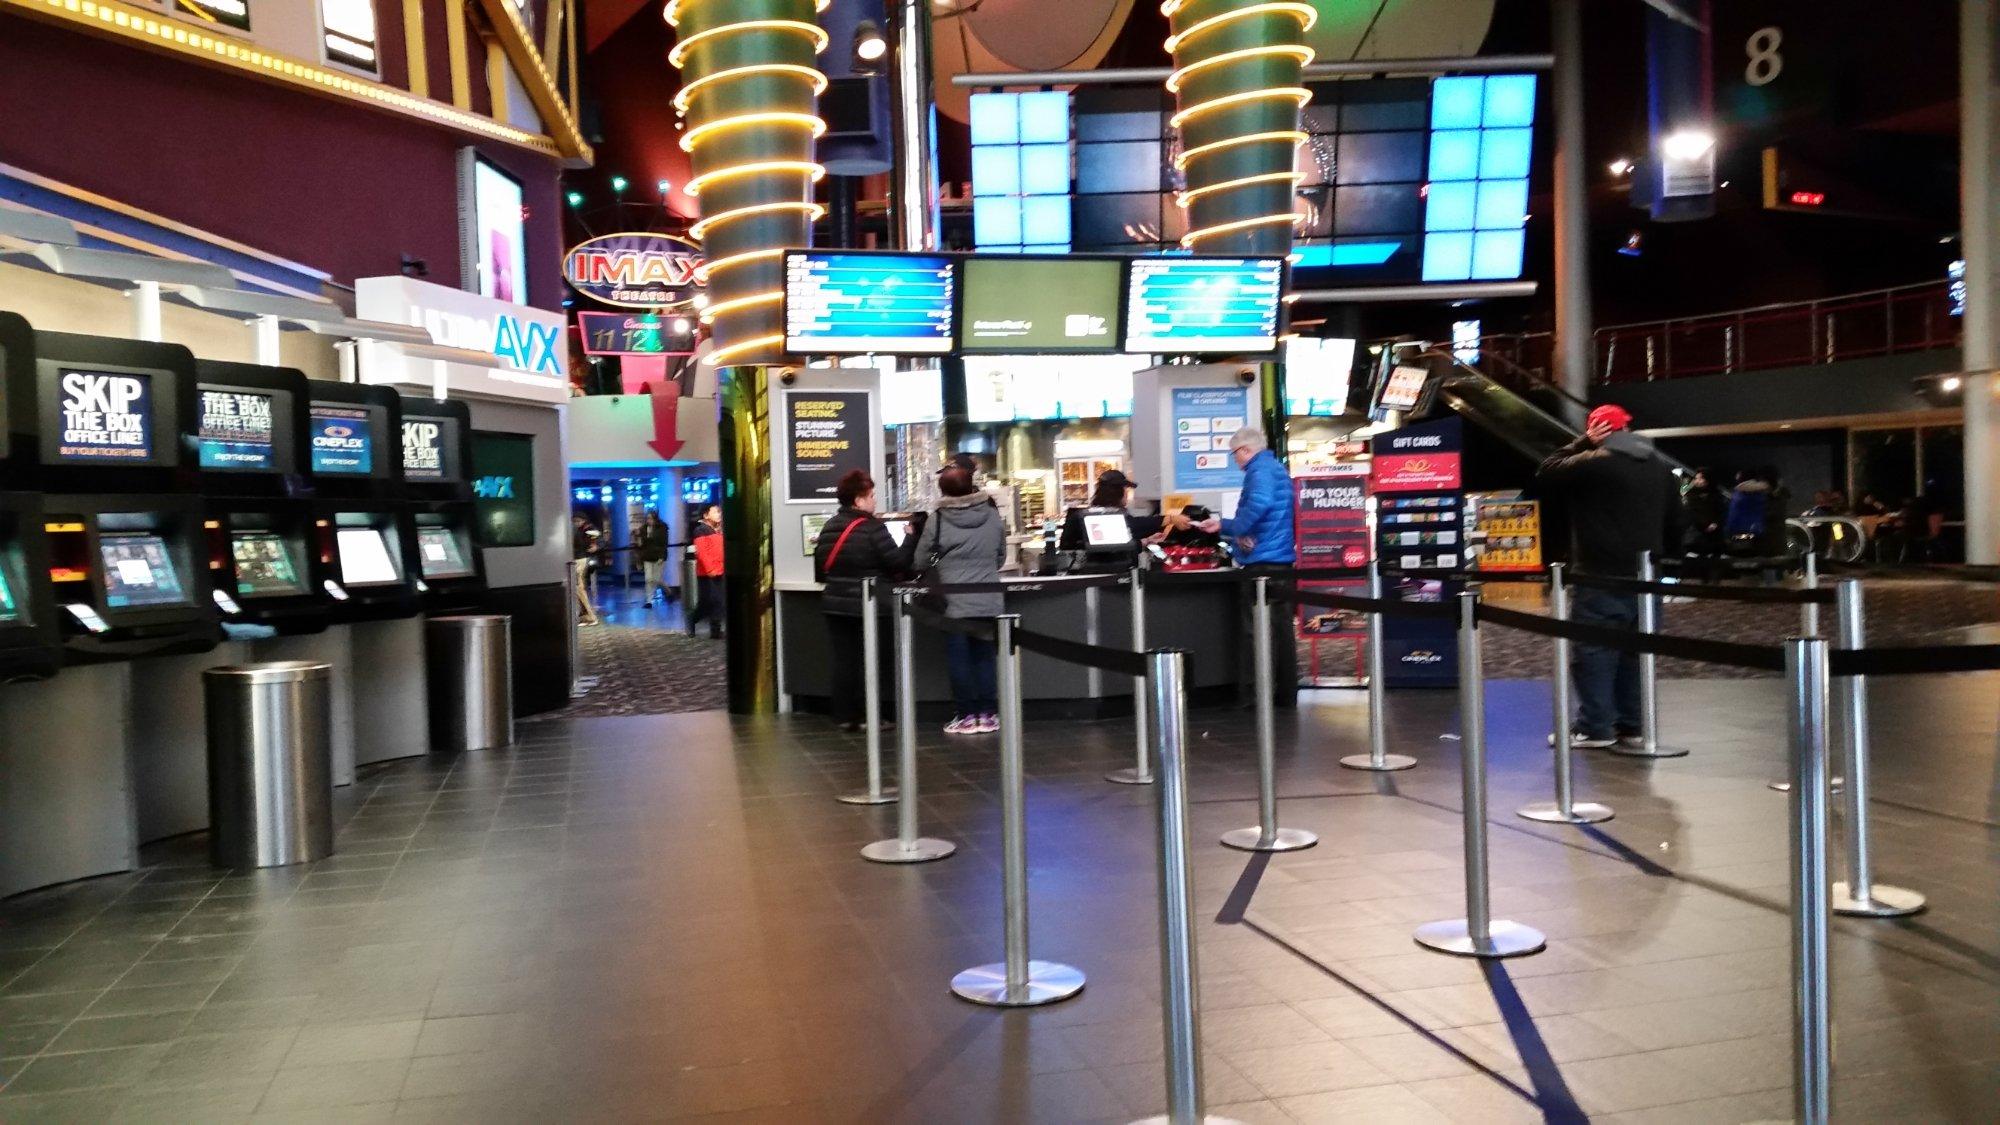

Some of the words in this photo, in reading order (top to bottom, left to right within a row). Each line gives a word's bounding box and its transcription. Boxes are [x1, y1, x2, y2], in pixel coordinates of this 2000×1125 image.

[1745, 27, 1783, 86] 8
[574, 252, 707, 287] IMAX
[494, 314, 562, 375] AVX
[593, 329, 616, 351] 11
[62, 373, 142, 414] SKIP
[202, 397, 235, 415] THE
[239, 399, 271, 418] BOX
[795, 401, 846, 410] RESERVED
[795, 409, 838, 418] SEATING.
[63, 410, 103, 431] THE
[105, 412, 143, 432] BOX
[795, 420, 846, 430] STUNNING
[64, 429, 110, 444] OFFICE
[110, 431, 143, 445] LINE!
[795, 429, 838, 438] PICTURE.
[313, 437, 364, 448] CINEPLEX
[796, 440, 849, 450] IMMERSIVE
[1393, 437, 1413, 448] GIFT
[1412, 435, 1442, 448] CARDS
[418, 447, 440, 460] BOX
[1300, 488, 1326, 499] END
[1326, 486, 1361, 498] YOUR
[1313, 496, 1366, 509] HUNGER
